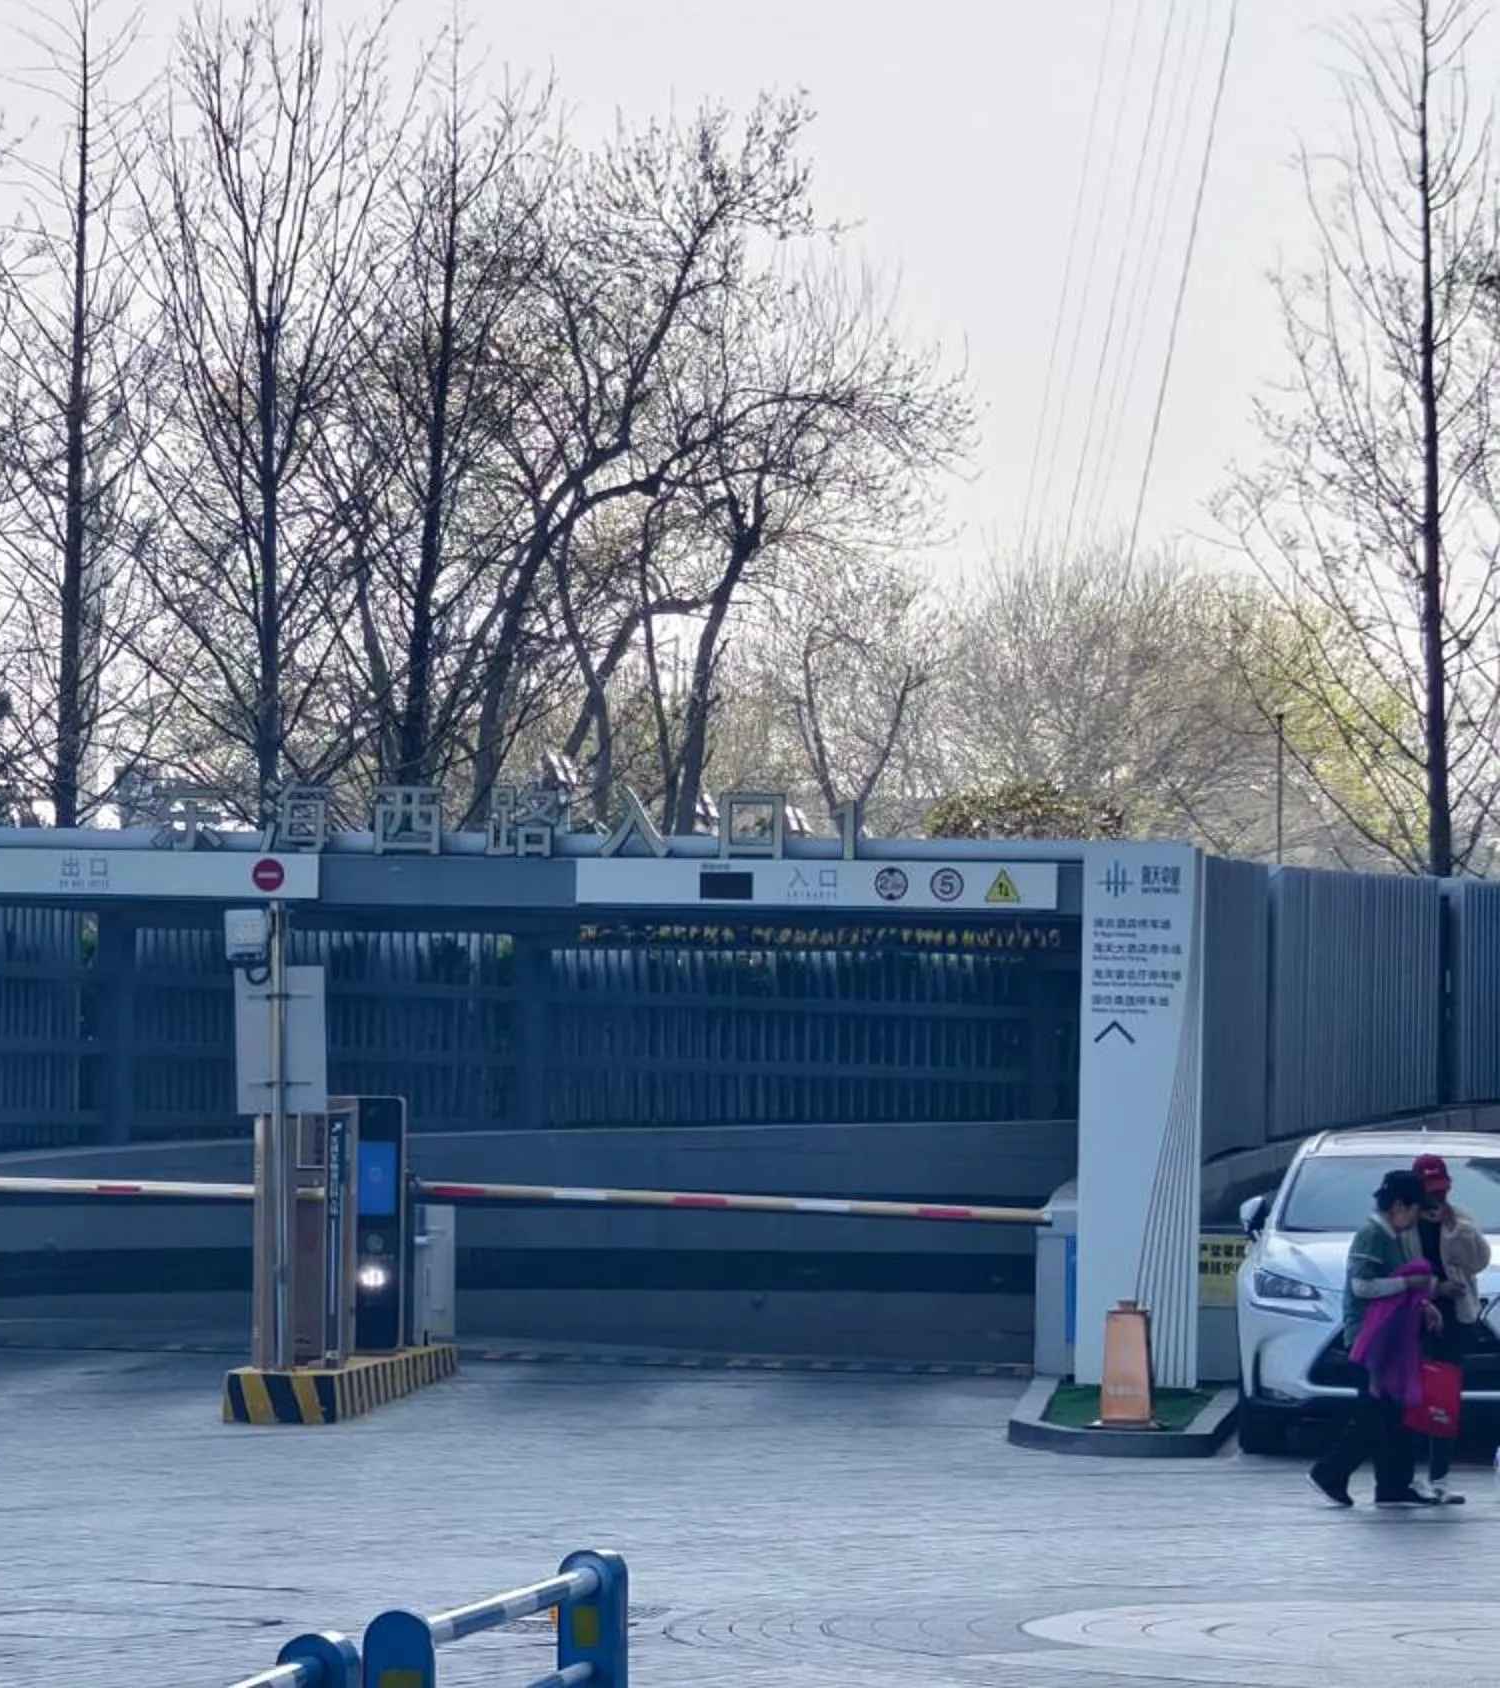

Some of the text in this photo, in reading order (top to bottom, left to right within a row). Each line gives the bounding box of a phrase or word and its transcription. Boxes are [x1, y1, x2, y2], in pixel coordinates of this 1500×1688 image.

[61, 853, 108, 877] 出口
[788, 866, 837, 888] 入口
[940, 875, 954, 895] 5
